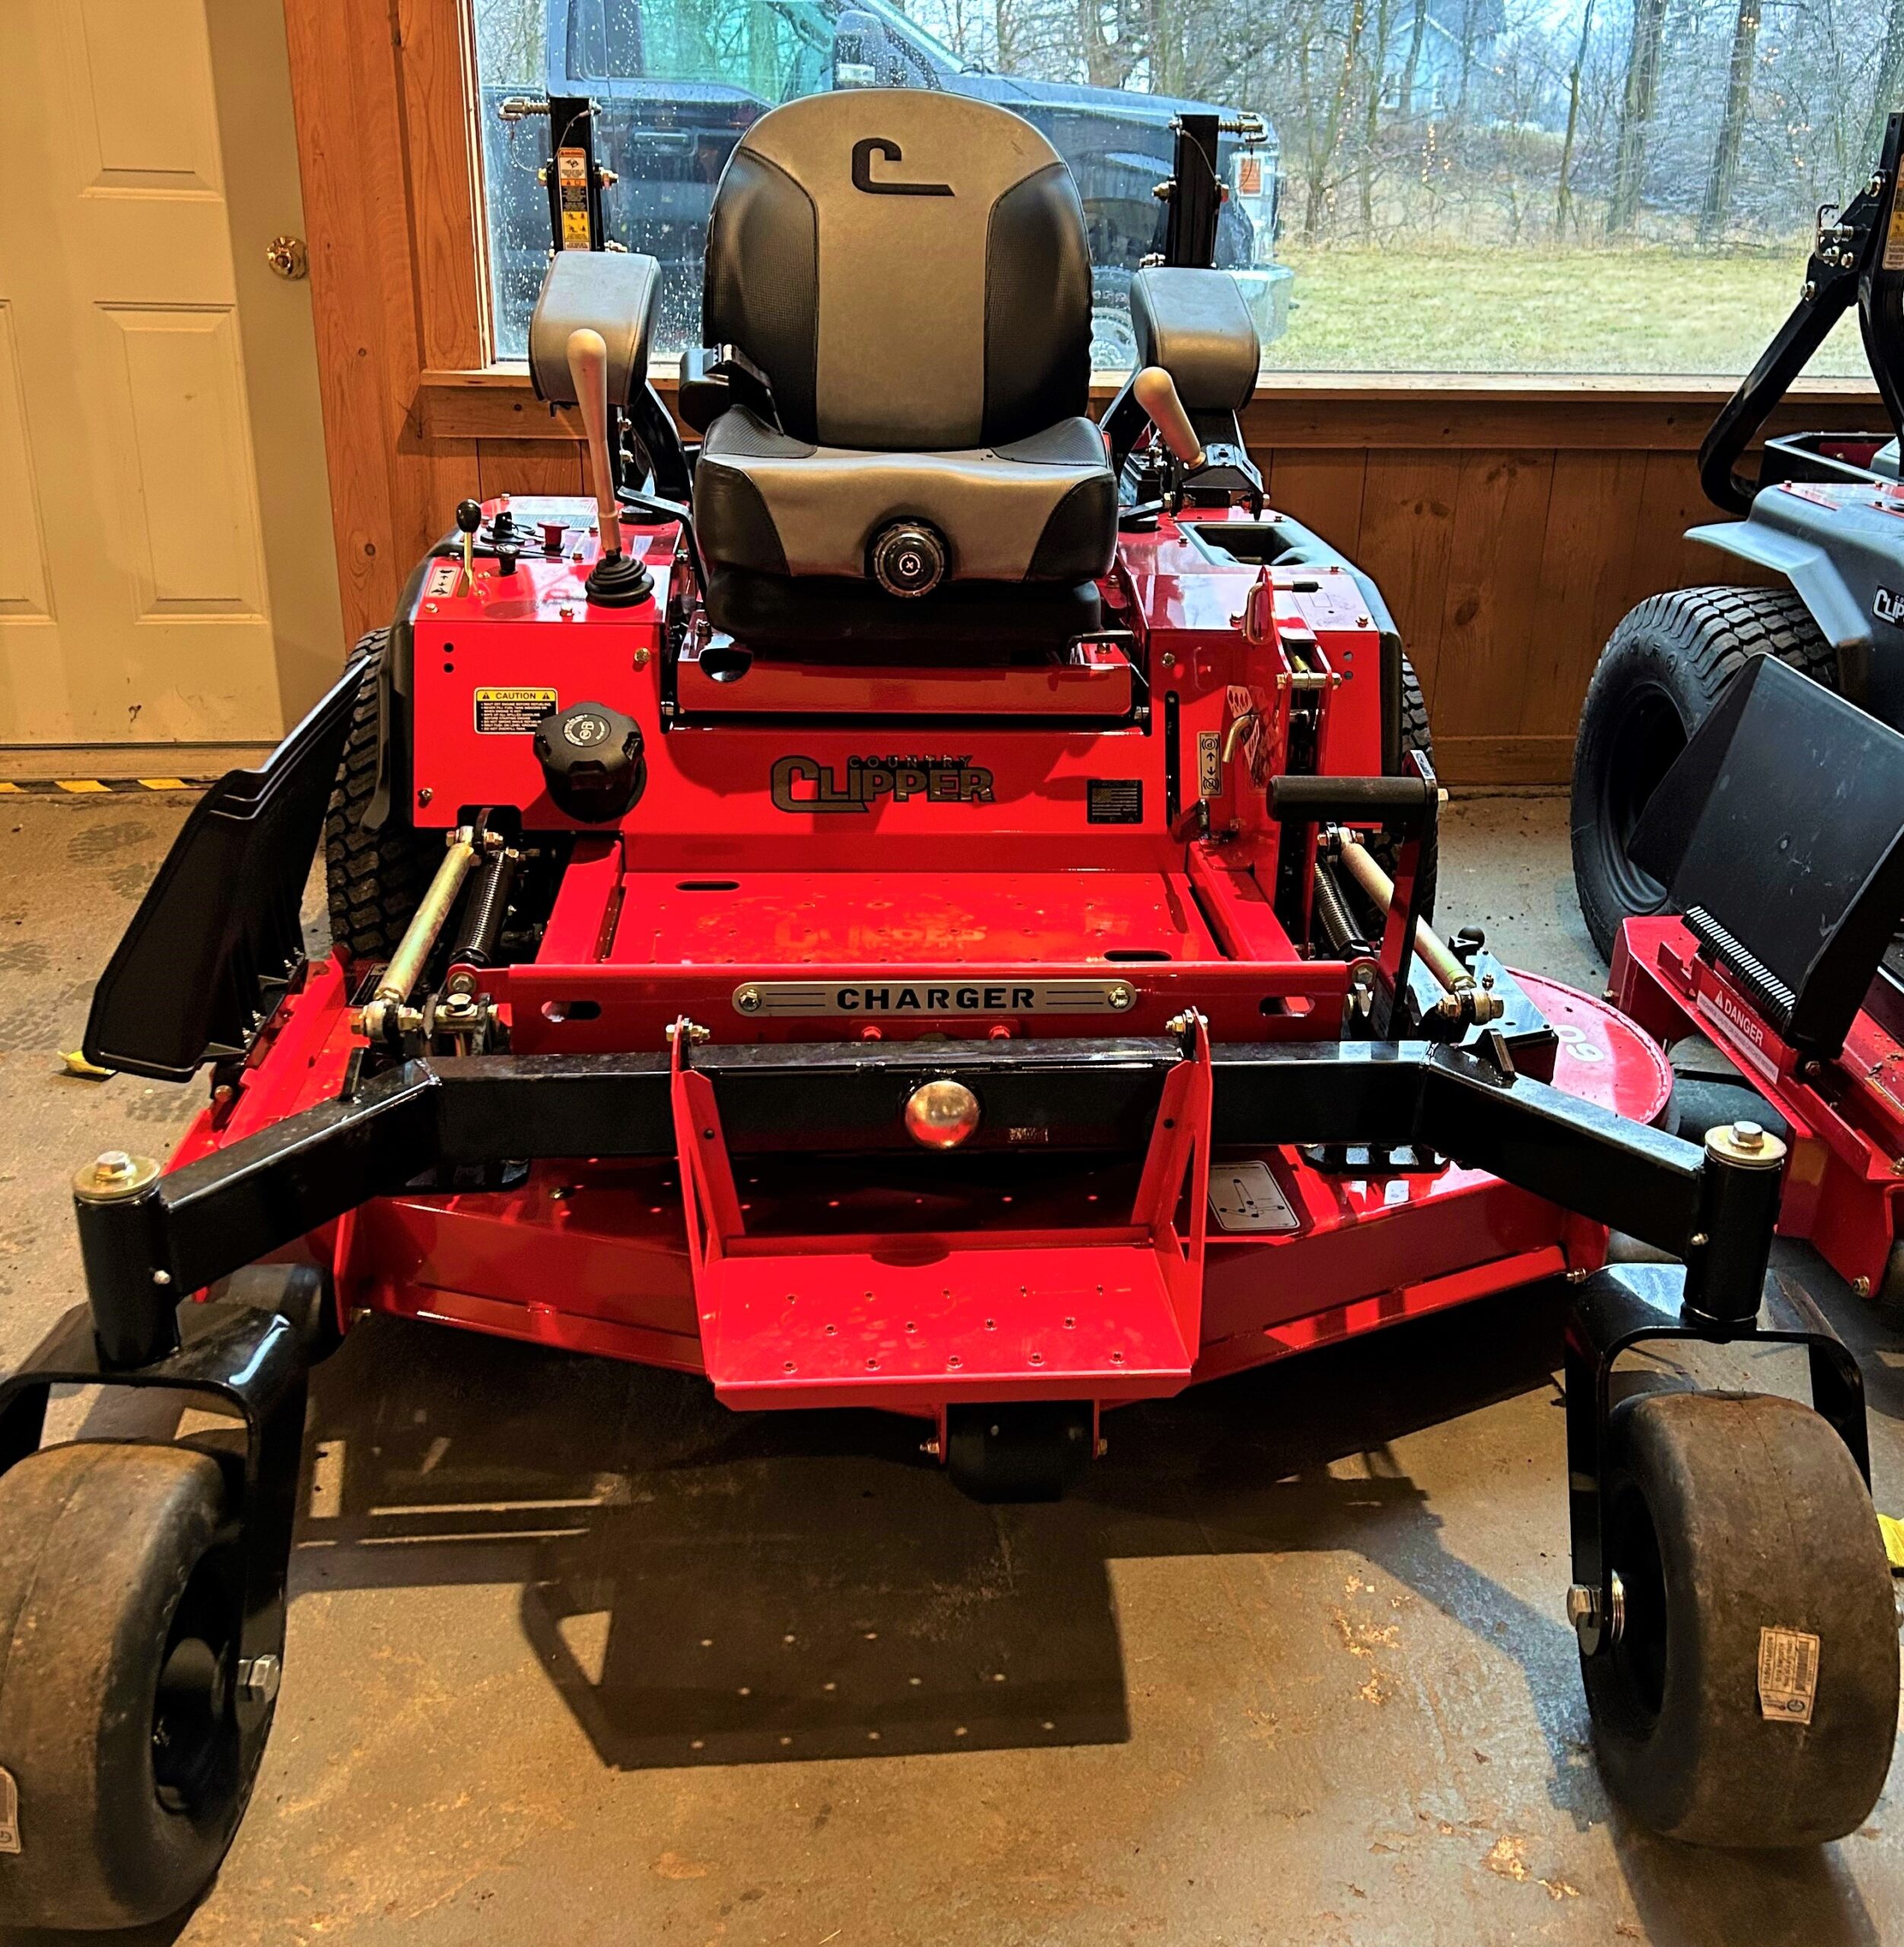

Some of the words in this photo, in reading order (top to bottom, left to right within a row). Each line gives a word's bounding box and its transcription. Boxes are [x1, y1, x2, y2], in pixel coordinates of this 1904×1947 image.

[1873, 589, 1904, 624] CLIP
[848, 755, 973, 768] COUNTRY
[771, 755, 996, 813] CLIPPER
[837, 987, 1035, 1010] CHARGER
[1724, 997, 1763, 1047] DANGER
